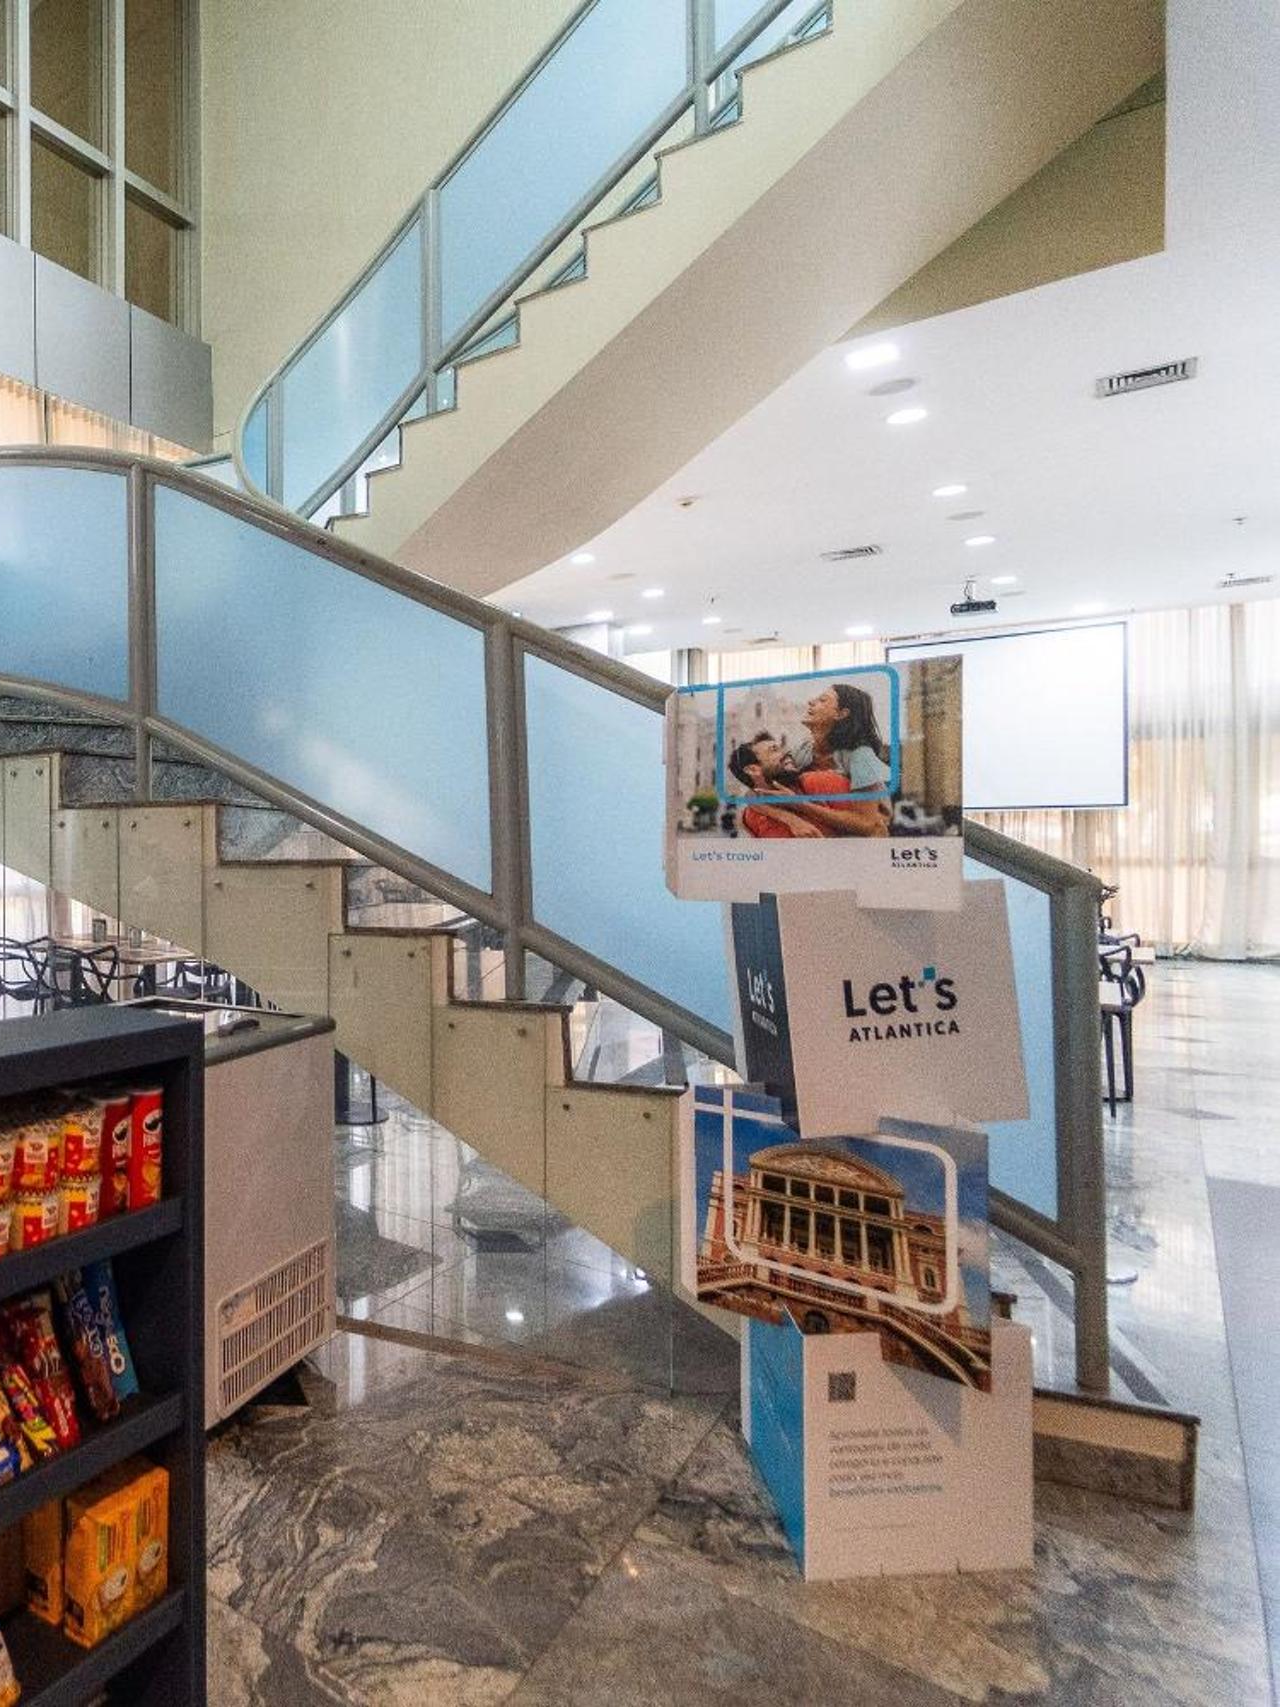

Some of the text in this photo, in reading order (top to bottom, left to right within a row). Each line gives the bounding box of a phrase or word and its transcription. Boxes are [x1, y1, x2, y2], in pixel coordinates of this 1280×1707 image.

[693, 850, 765, 862] Let's travel
[890, 846, 938, 861] Let's
[746, 966, 776, 1014] Let's
[842, 966, 958, 1018] Let's
[849, 1020, 960, 1043] ATLANTICA
